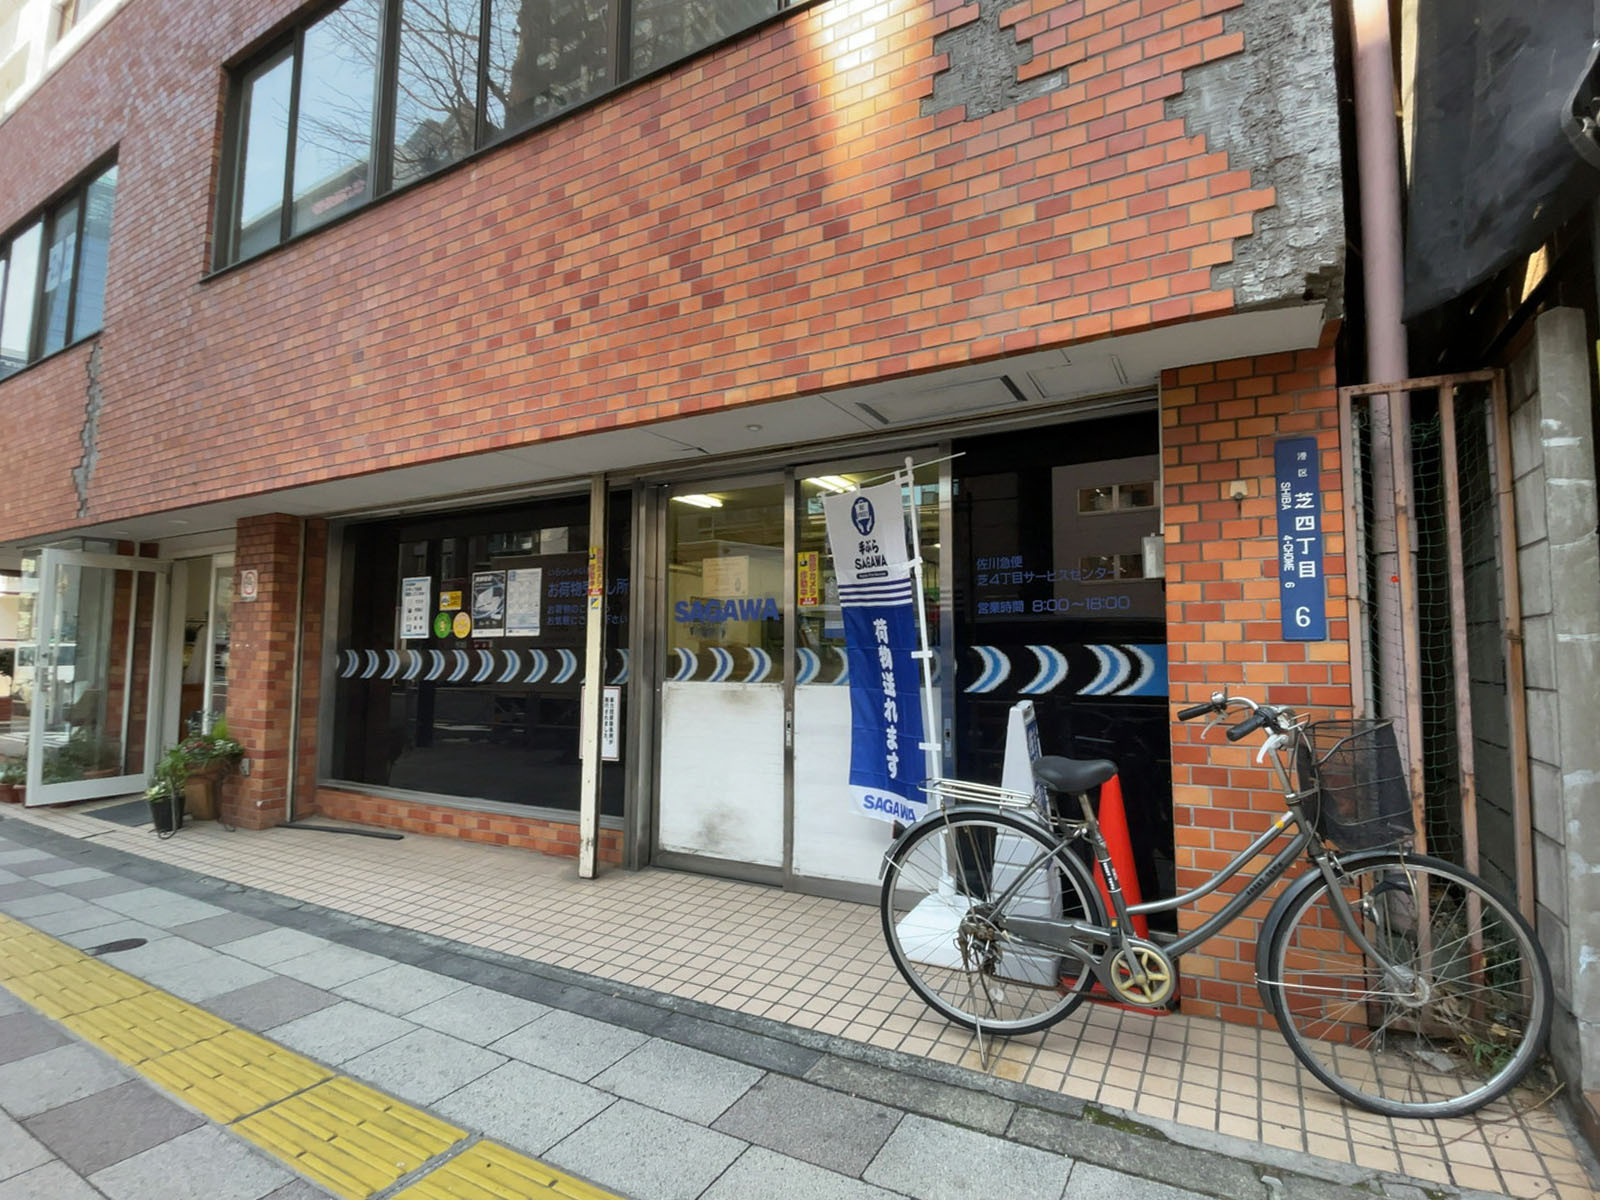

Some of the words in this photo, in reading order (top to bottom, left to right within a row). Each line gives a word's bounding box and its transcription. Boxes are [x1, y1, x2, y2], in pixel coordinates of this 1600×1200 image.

[1297, 451, 1308, 478] 港区
[1280, 481, 1292, 511] SHIBA
[1294, 491, 1316, 578] 芝四丁目
[858, 539, 880, 555] 手ぶら
[854, 554, 888, 570] SAGAWA
[976, 554, 1024, 570] 佐川急便
[1284, 581, 1296, 589] 6
[674, 597, 780, 623] SAGAWA
[976, 600, 1025, 615] 営業時間
[1295, 606, 1311, 628] 6
[873, 618, 899, 779] 荷物送れます
[863, 794, 917, 823] SAGAWA
